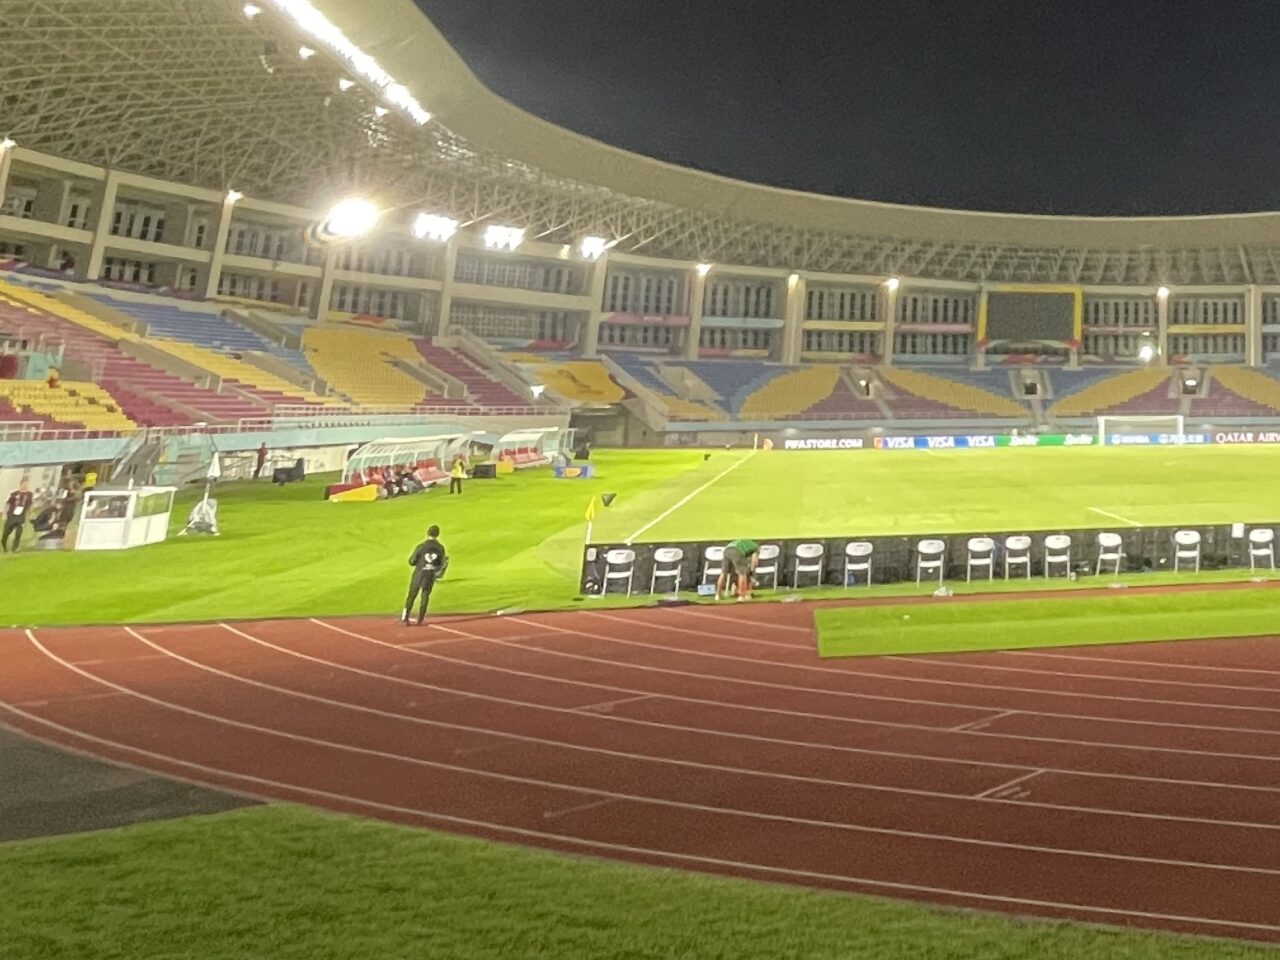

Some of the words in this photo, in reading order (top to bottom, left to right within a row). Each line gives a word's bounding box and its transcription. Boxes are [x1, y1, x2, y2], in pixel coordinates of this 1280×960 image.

[886, 436, 914, 449] VISA
[927, 436, 955, 449] VISA
[967, 436, 994, 448] VISA
[1216, 433, 1253, 443] QATAR
